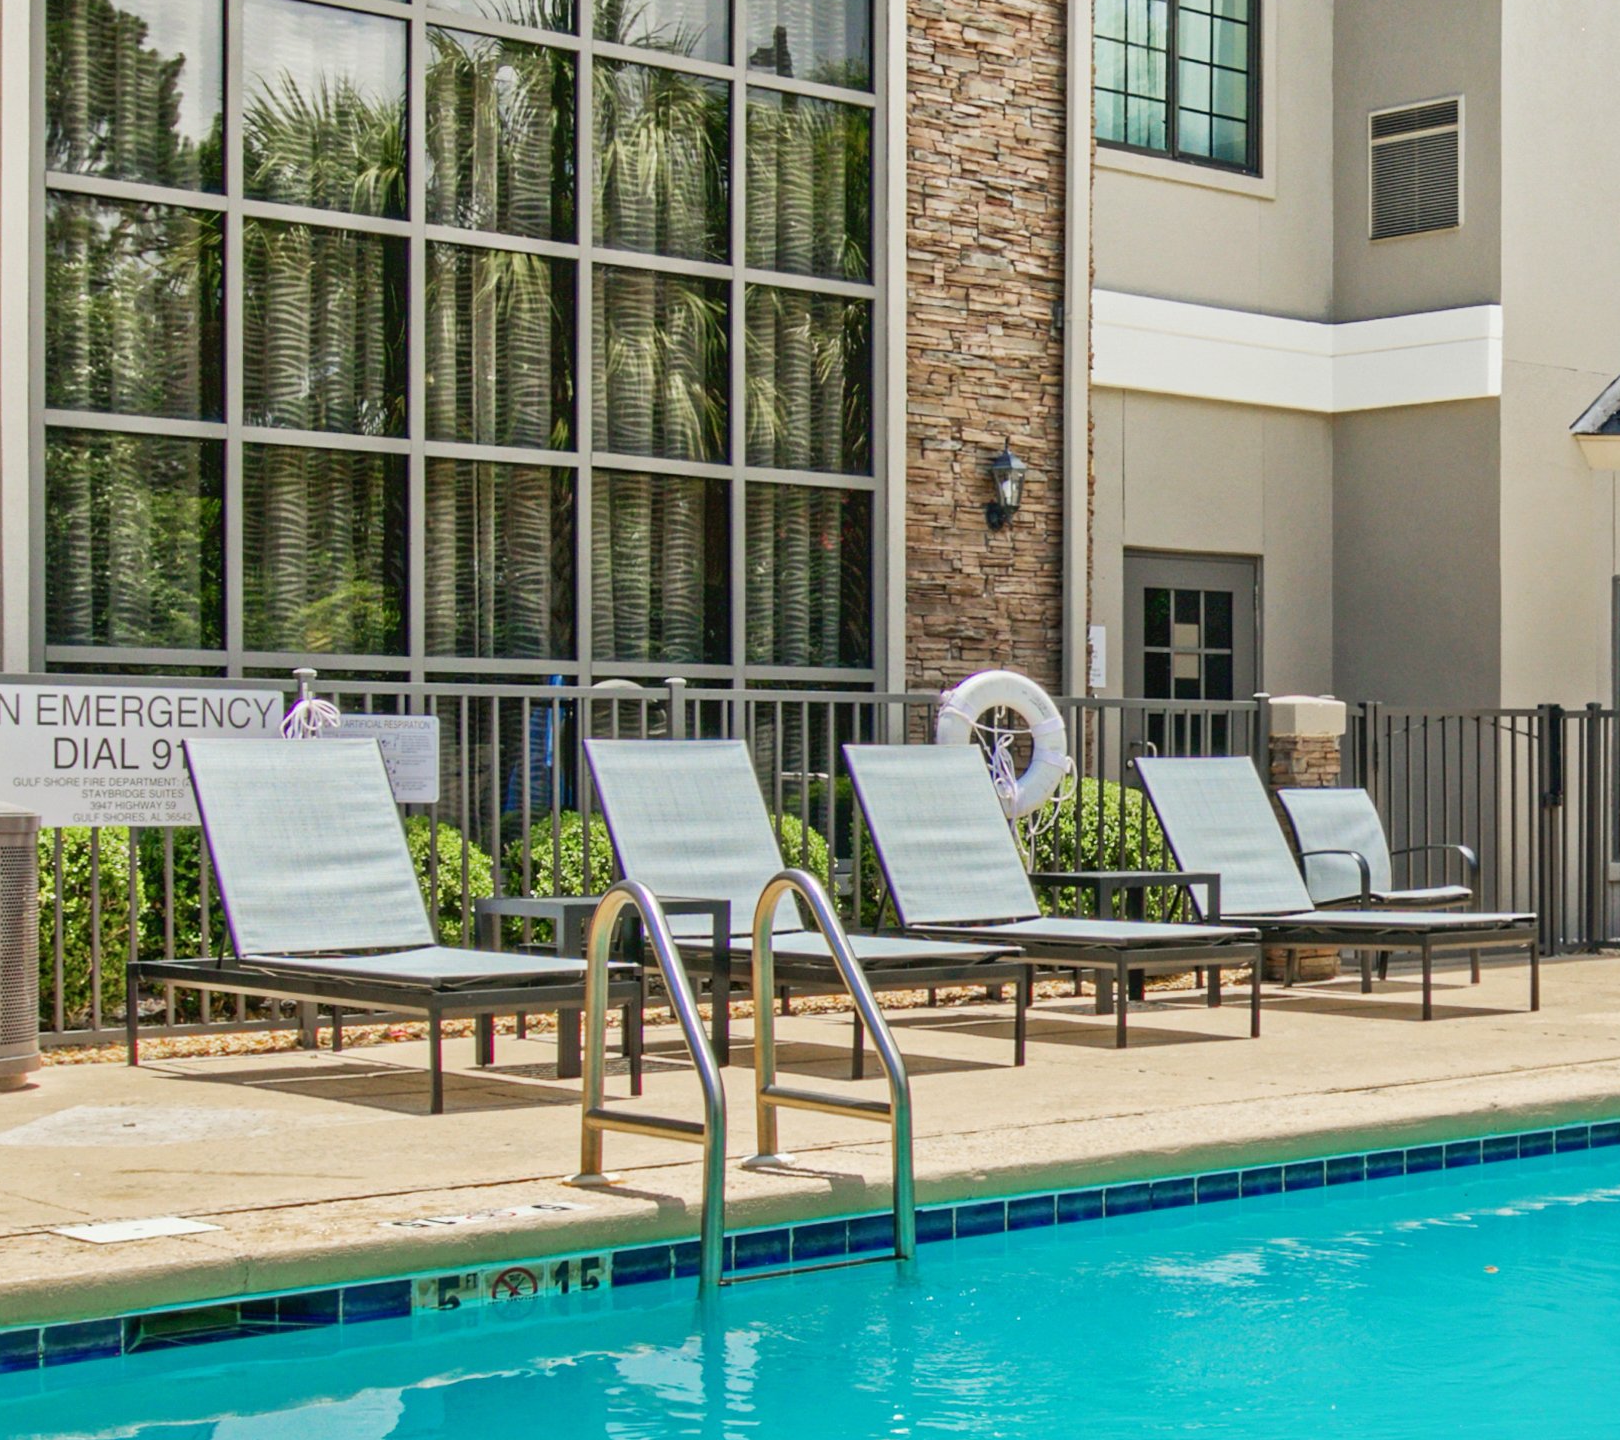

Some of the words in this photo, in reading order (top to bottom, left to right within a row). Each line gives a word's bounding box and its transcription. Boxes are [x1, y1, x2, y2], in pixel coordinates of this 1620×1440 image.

[36, 694, 276, 729] EMERGENCY
[345, 720, 382, 728] ARTIFICIAL
[384, 720, 430, 729] RESPIRATION
[54, 737, 140, 770] DIAL
[13, 778, 41, 787] GULF
[44, 778, 80, 787] SHORE
[83, 778, 105, 787] FIRE
[109, 778, 180, 787] DEPARTMENT:
[82, 789, 146, 798] STAYBRIDGE
[148, 789, 184, 798] SUITES
[90, 802, 112, 810] 3947
[115, 801, 162, 810] HIGHWAY
[165, 801, 176, 810] 59
[73, 813, 100, 822] GULF
[102, 813, 148, 823] SHORES,
[150, 813, 162, 822] AL
[165, 812, 192, 822] 36542
[438, 1275, 461, 1310] 5
[466, 1273, 478, 1289] FT
